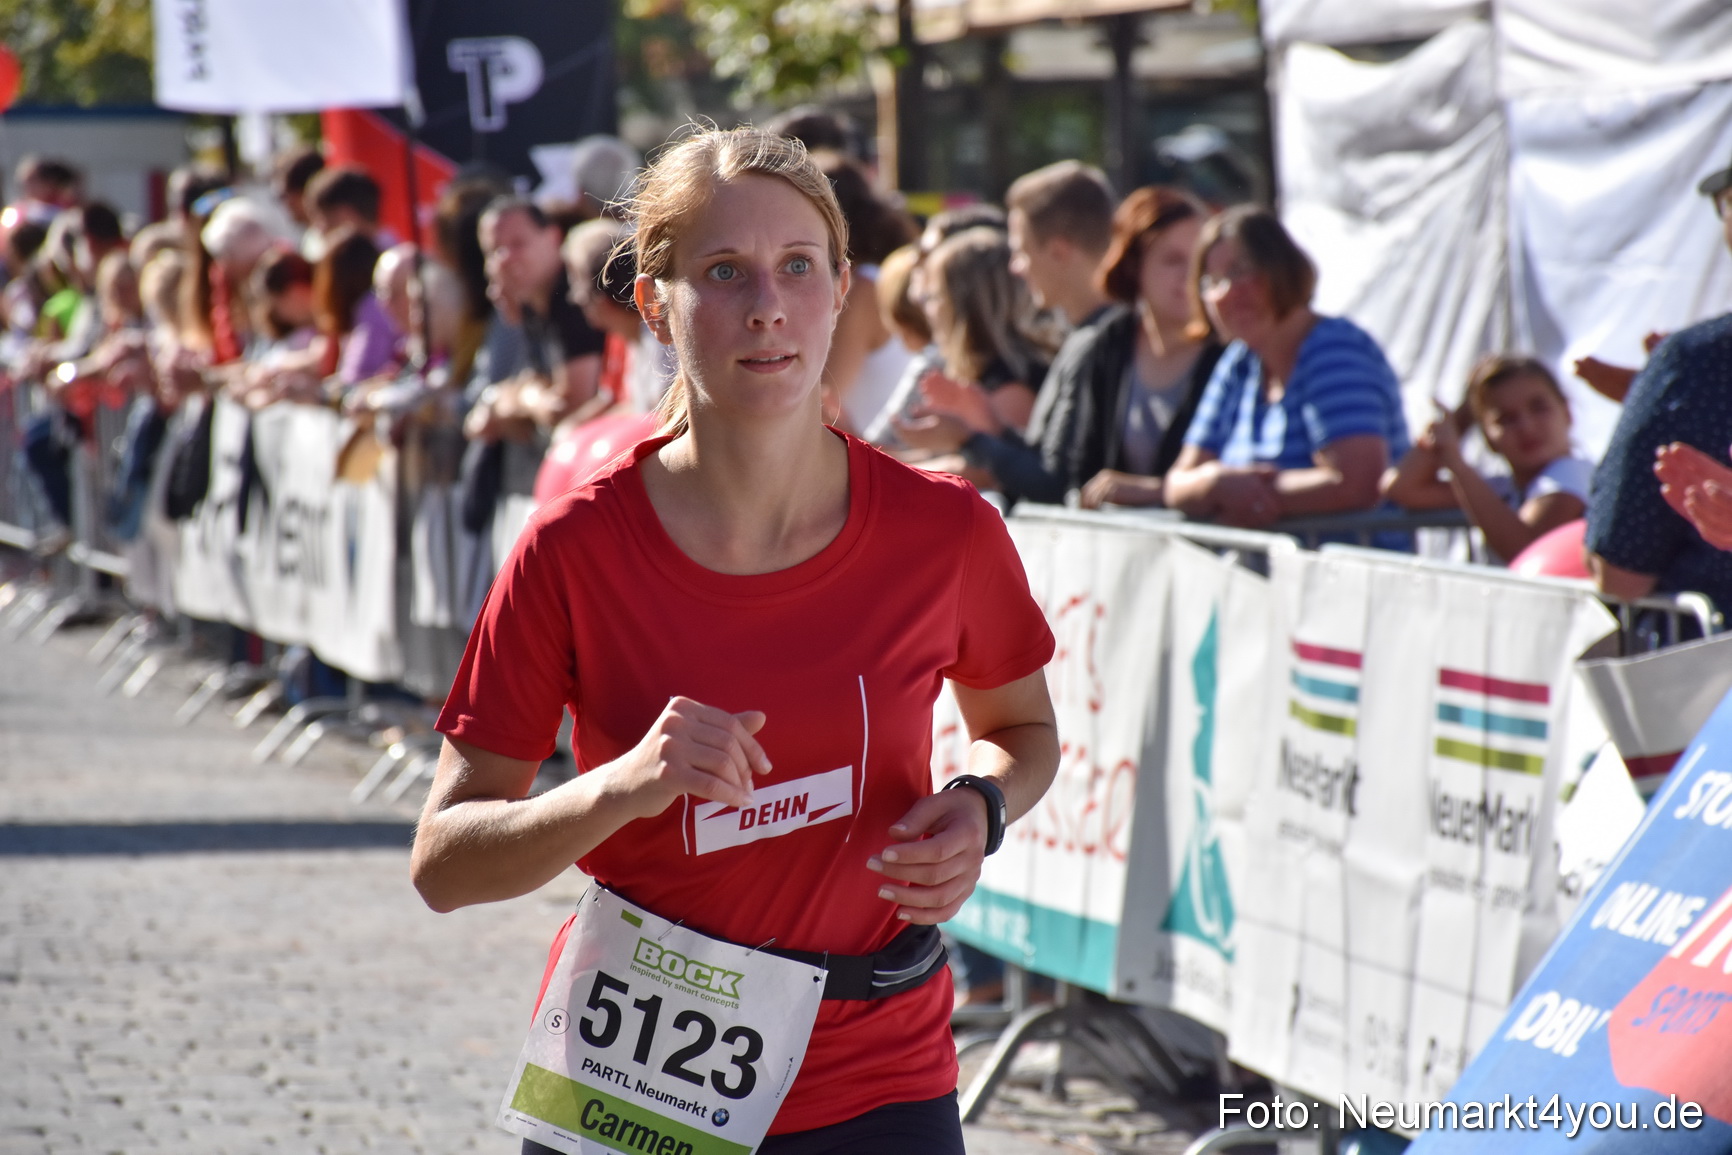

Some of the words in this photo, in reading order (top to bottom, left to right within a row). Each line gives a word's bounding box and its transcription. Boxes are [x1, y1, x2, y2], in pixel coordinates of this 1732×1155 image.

[738, 792, 809, 831] DEHN
[630, 962, 662, 982] inspired
[662, 976, 673, 988] by
[674, 983, 699, 997] smart
[700, 992, 740, 1010] concepts
[633, 937, 745, 1000] BOCK
[551, 1015, 562, 1028] S
[579, 970, 764, 1100] 5123
[581, 1058, 632, 1091] PARTL
[634, 1082, 708, 1118] Neumarkt
[580, 1098, 694, 1155] Carmen
